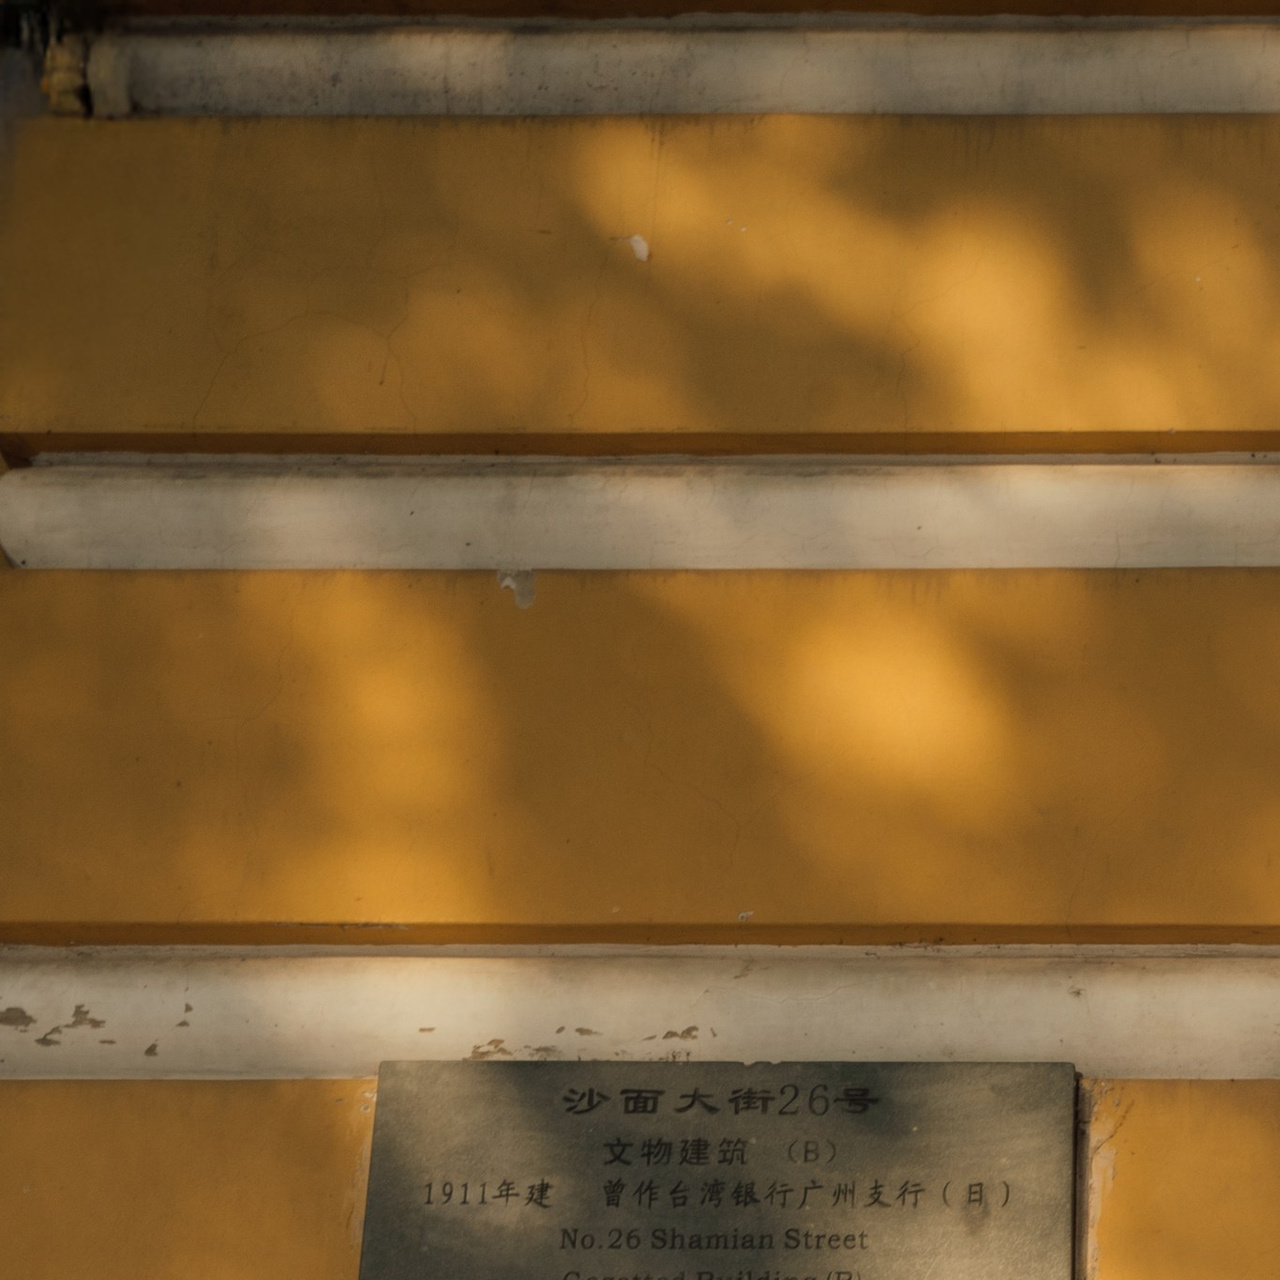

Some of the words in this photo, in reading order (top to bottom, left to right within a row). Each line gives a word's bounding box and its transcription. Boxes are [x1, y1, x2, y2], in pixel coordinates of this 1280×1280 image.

[562, 1084, 880, 1116] 沙面大街26号
[603, 1137, 748, 1166] 文物建筑
[423, 1178, 554, 1209] 1911年建
[559, 1228, 642, 1251] No.26
[650, 1228, 775, 1251] Shamian
[783, 1228, 869, 1251] Street
